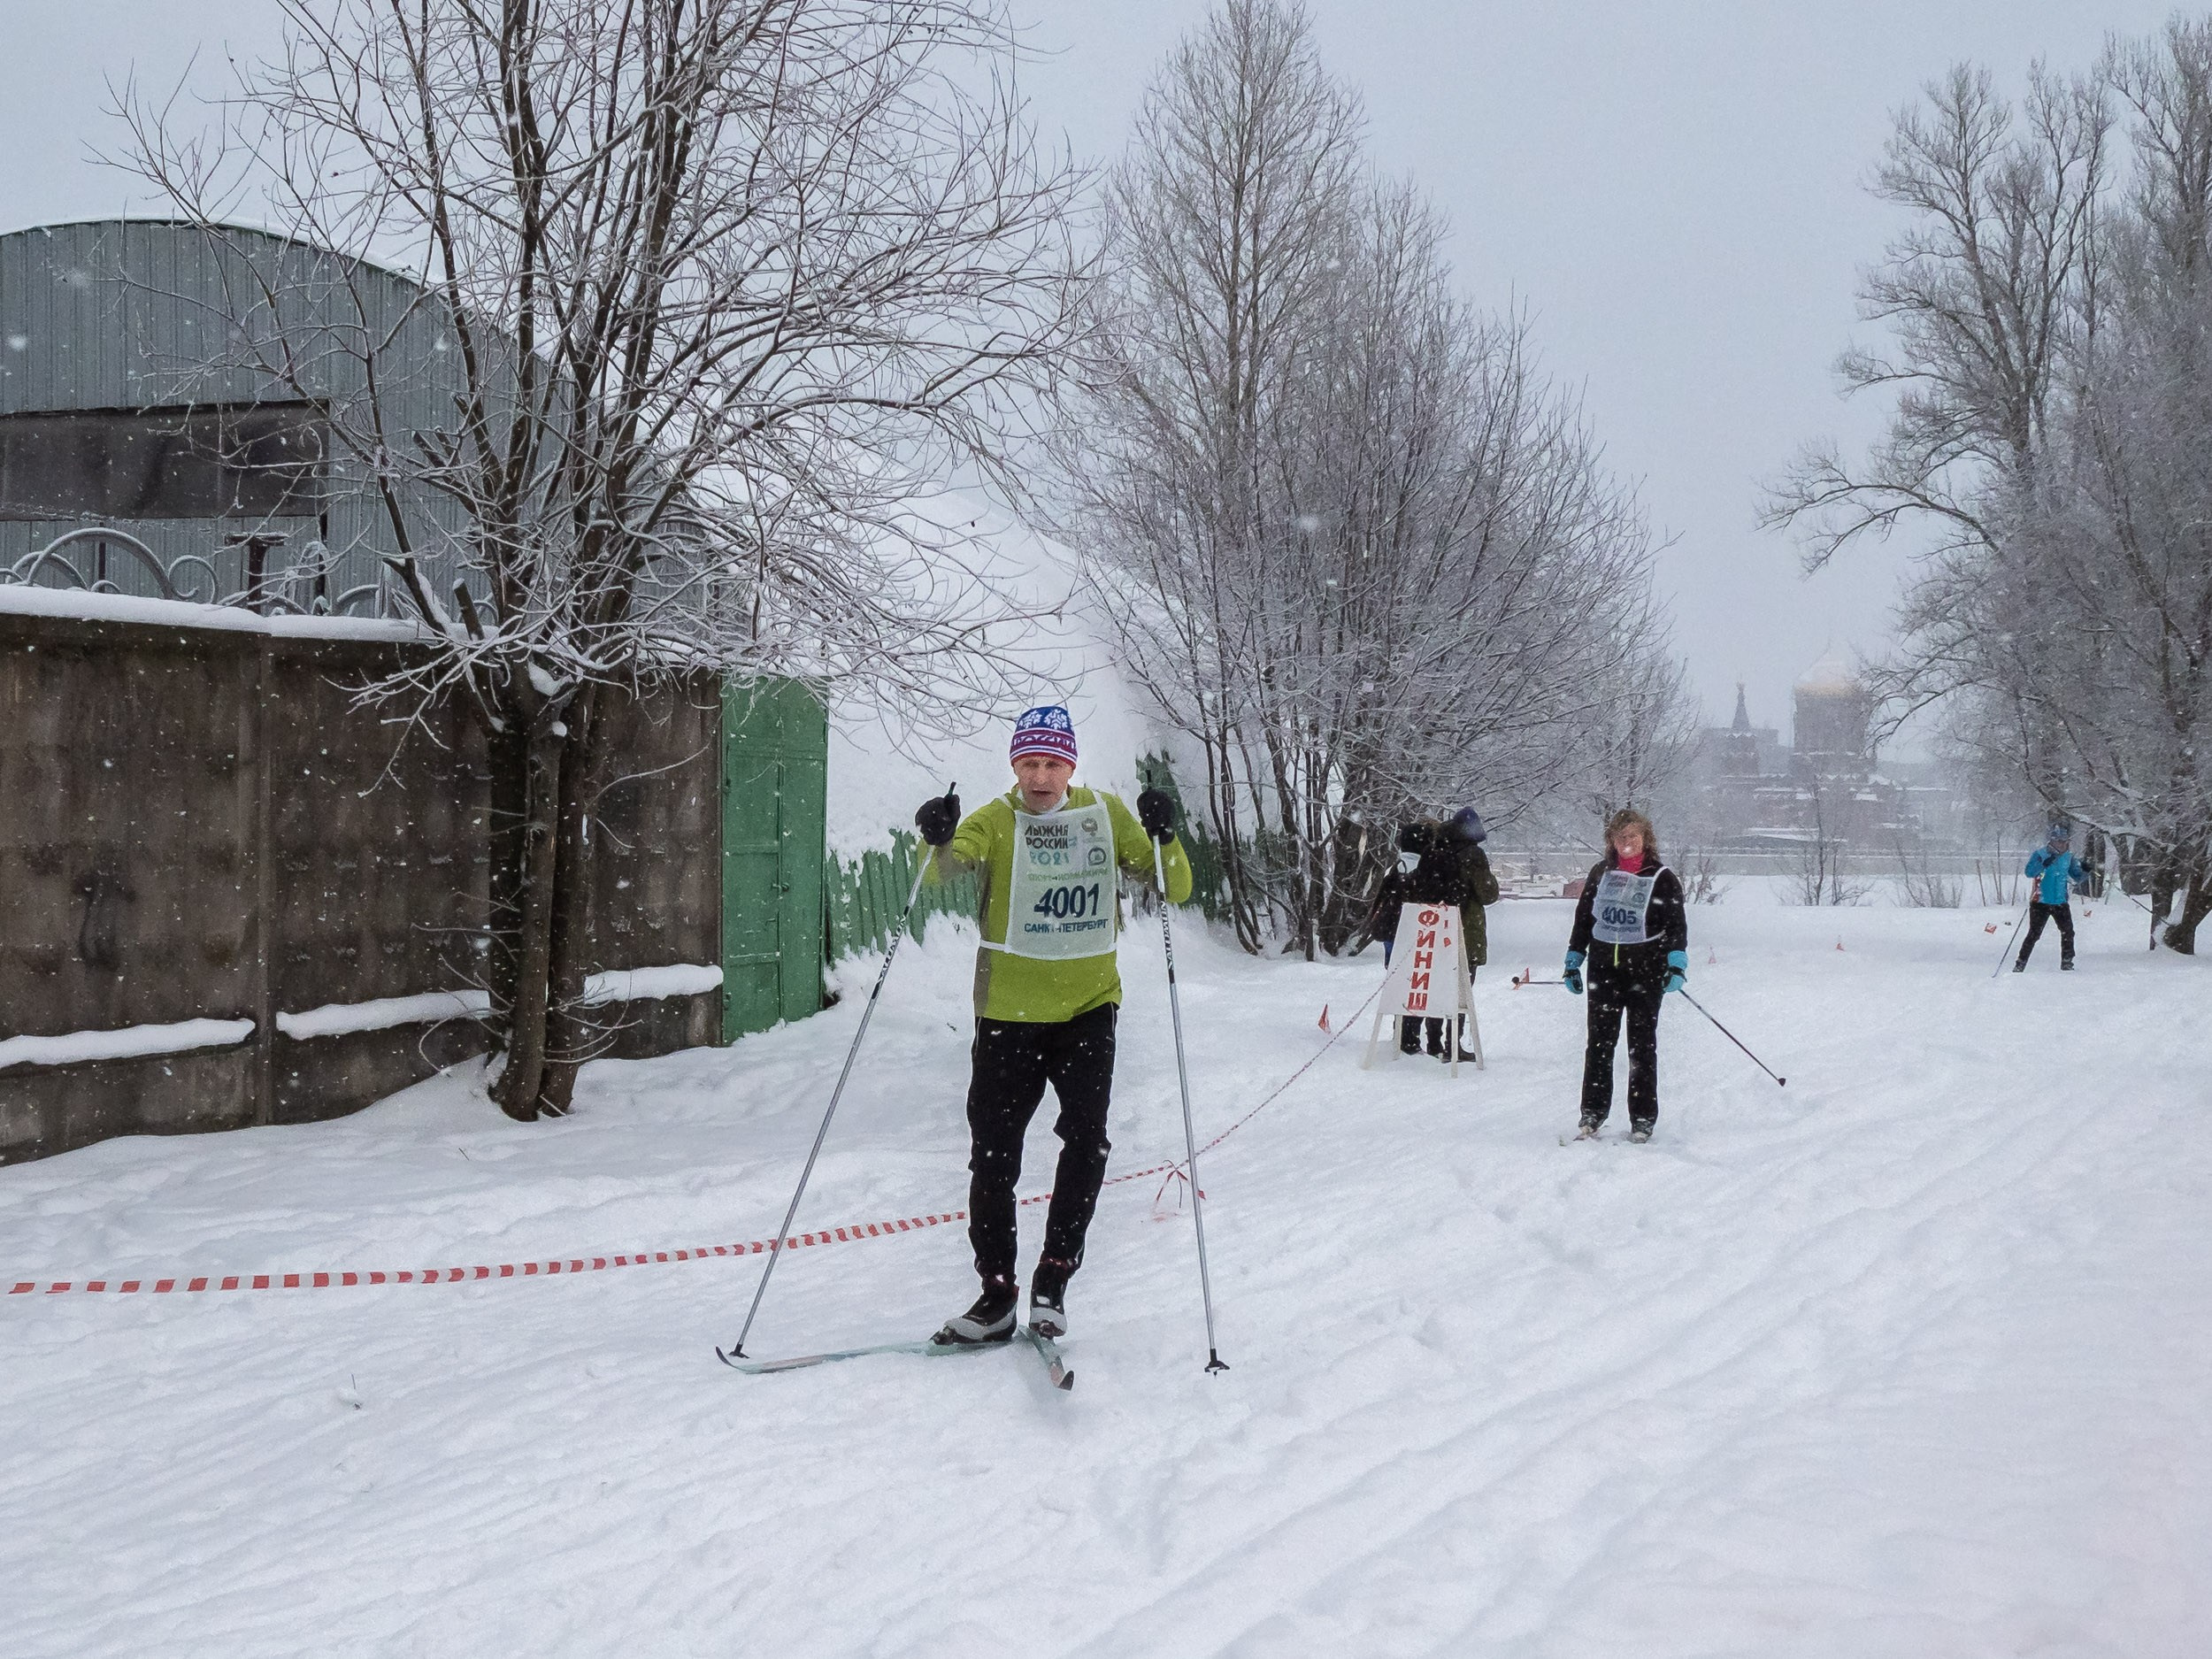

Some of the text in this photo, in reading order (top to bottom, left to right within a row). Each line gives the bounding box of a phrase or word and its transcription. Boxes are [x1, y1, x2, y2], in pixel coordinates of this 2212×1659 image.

[1025, 824, 1069, 836] ЛЫЖНЯ
[1025, 837, 1069, 849] РОССИИ
[1029, 850, 1070, 865] 2021
[1033, 883, 1099, 918] 4001
[1602, 906, 1637, 925] 4005
[1025, 918, 1109, 933] САНК-ПЕТЕРБУРГ
[1408, 910, 1440, 1010] ФИНИШ
